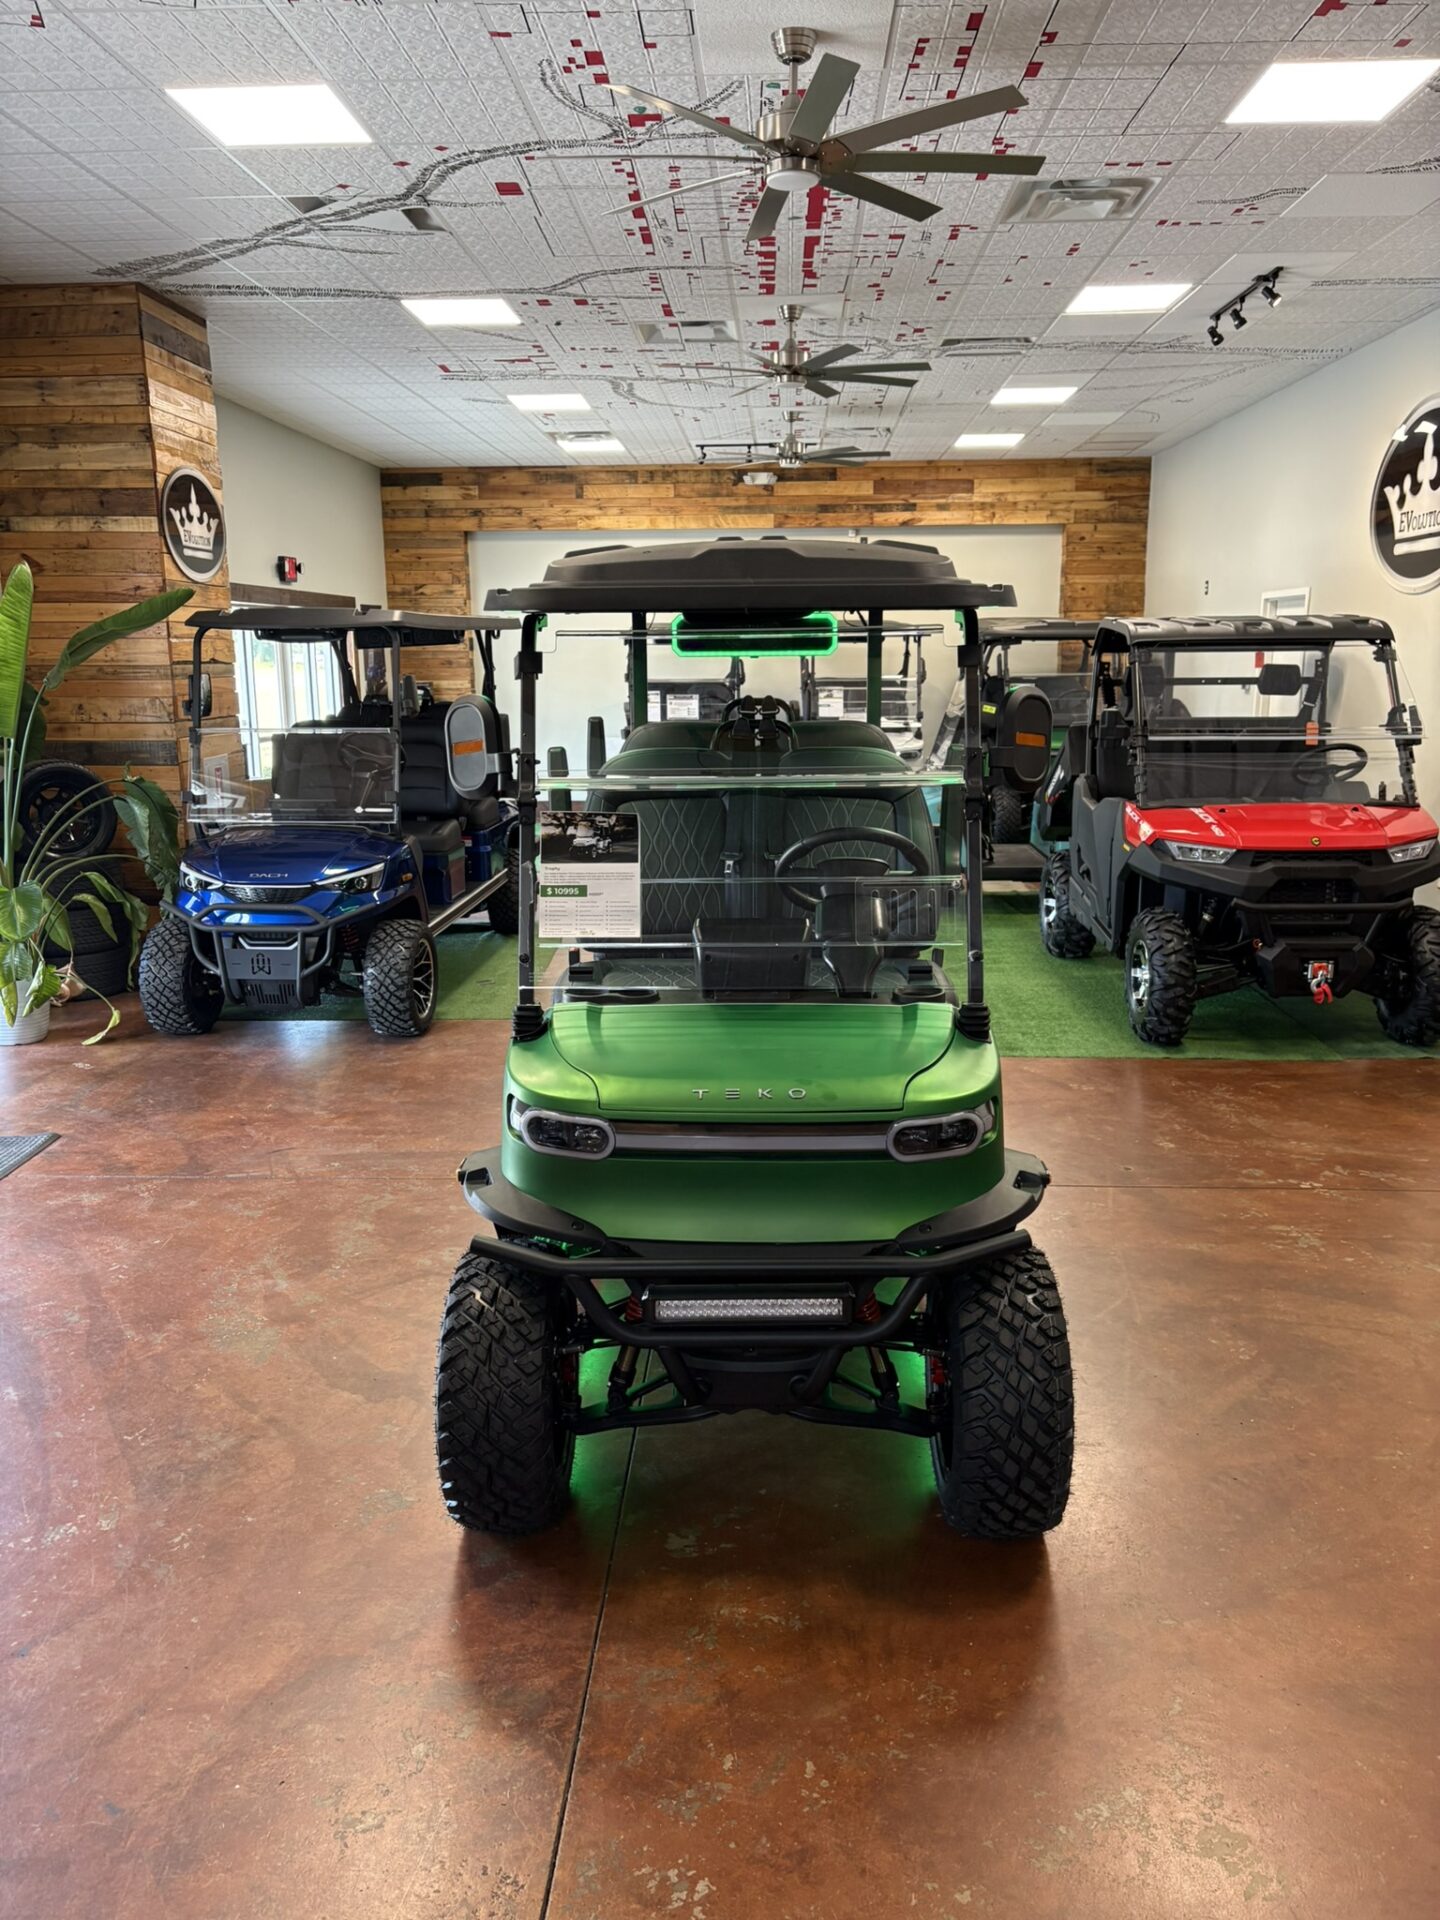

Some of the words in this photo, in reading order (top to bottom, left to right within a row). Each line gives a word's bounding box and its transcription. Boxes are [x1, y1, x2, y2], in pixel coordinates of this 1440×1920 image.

[546, 887, 553, 896] $
[554, 887, 580, 896] 10995
[691, 1087, 806, 1100] TEKO
